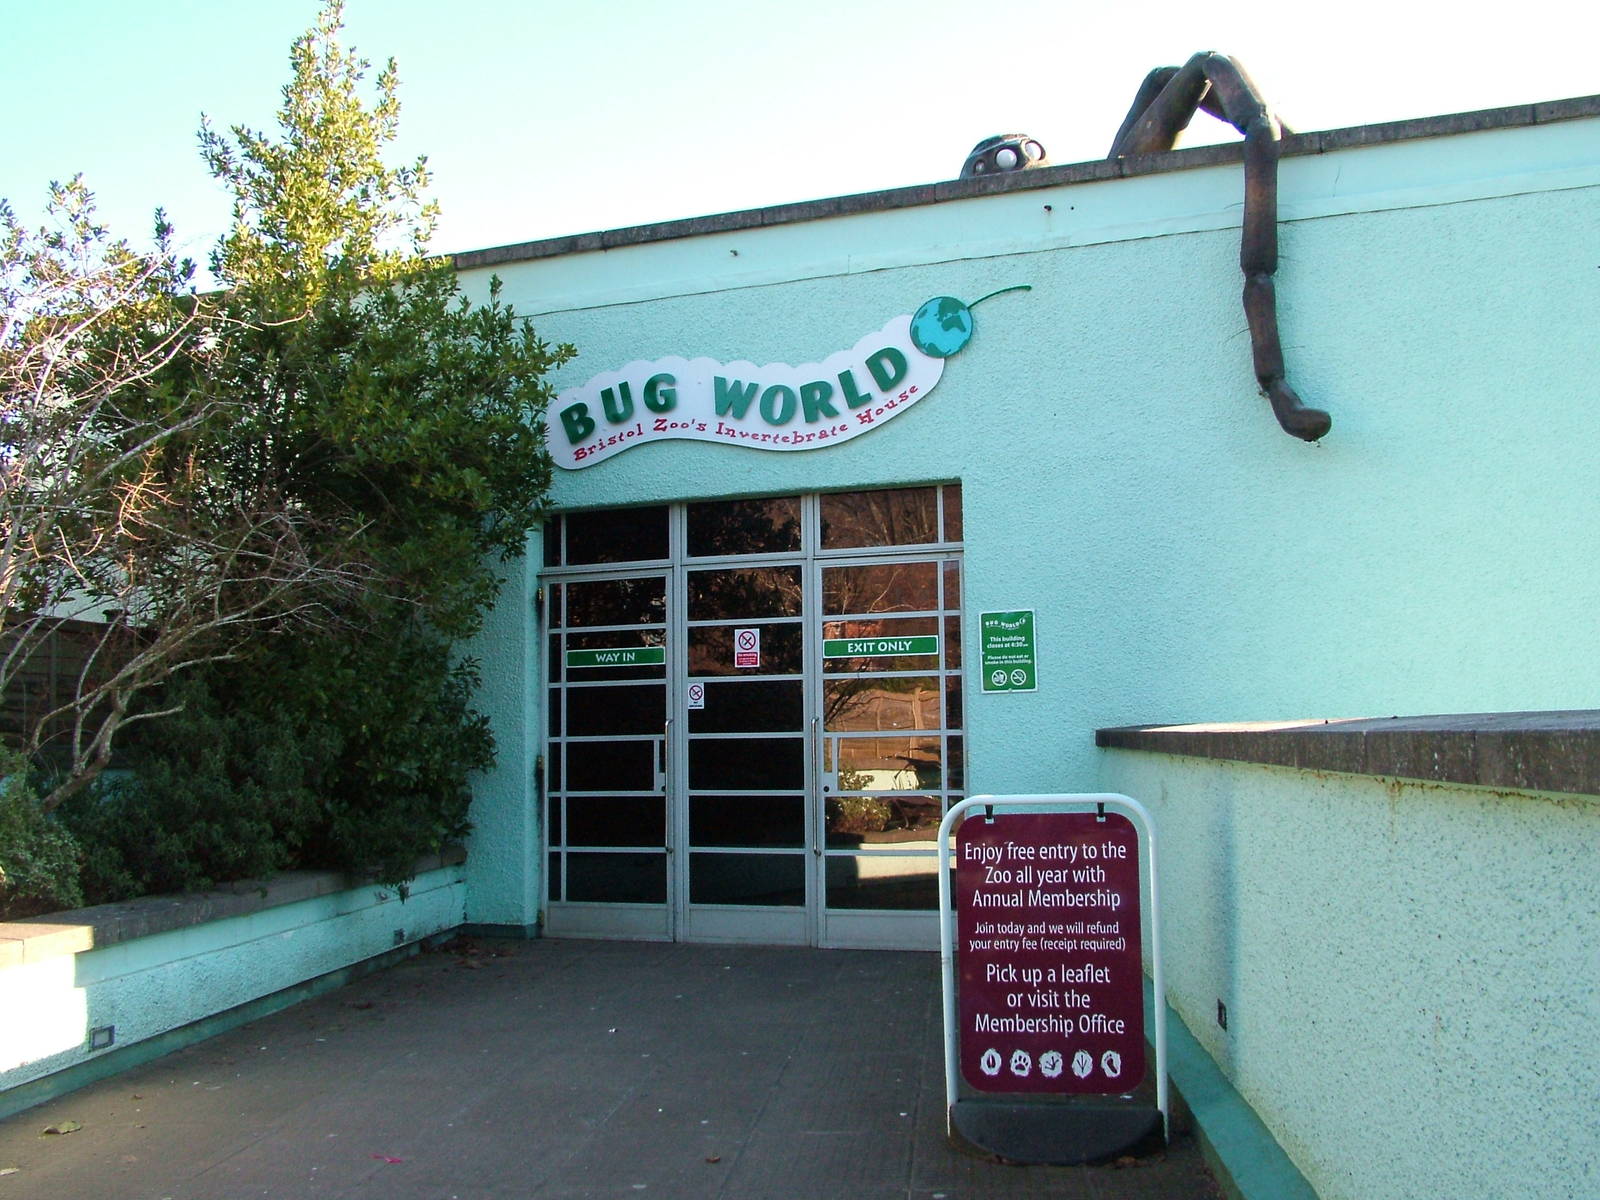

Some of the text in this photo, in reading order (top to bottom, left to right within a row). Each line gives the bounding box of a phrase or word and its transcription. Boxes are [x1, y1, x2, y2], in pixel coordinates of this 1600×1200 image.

[559, 347, 908, 445] BUG WORLD
[573, 384, 919, 462] Bristol Zoo's Invertebrate House
[847, 640, 912, 653] EXIT ONLY
[595, 653, 635, 663] WAY IN
[965, 841, 1126, 864] Enjoy free entry to the
[985, 866, 1105, 888] Zoo all year with
[972, 889, 1121, 910] Annual Membership
[975, 922, 1119, 937] Join today and we will refund
[969, 938, 1126, 953] your entry fee (receipt required)
[987, 964, 1110, 987] Pick up a leaflet
[1007, 990, 1091, 1008] or visit the
[975, 1014, 1125, 1037] Membership Office
